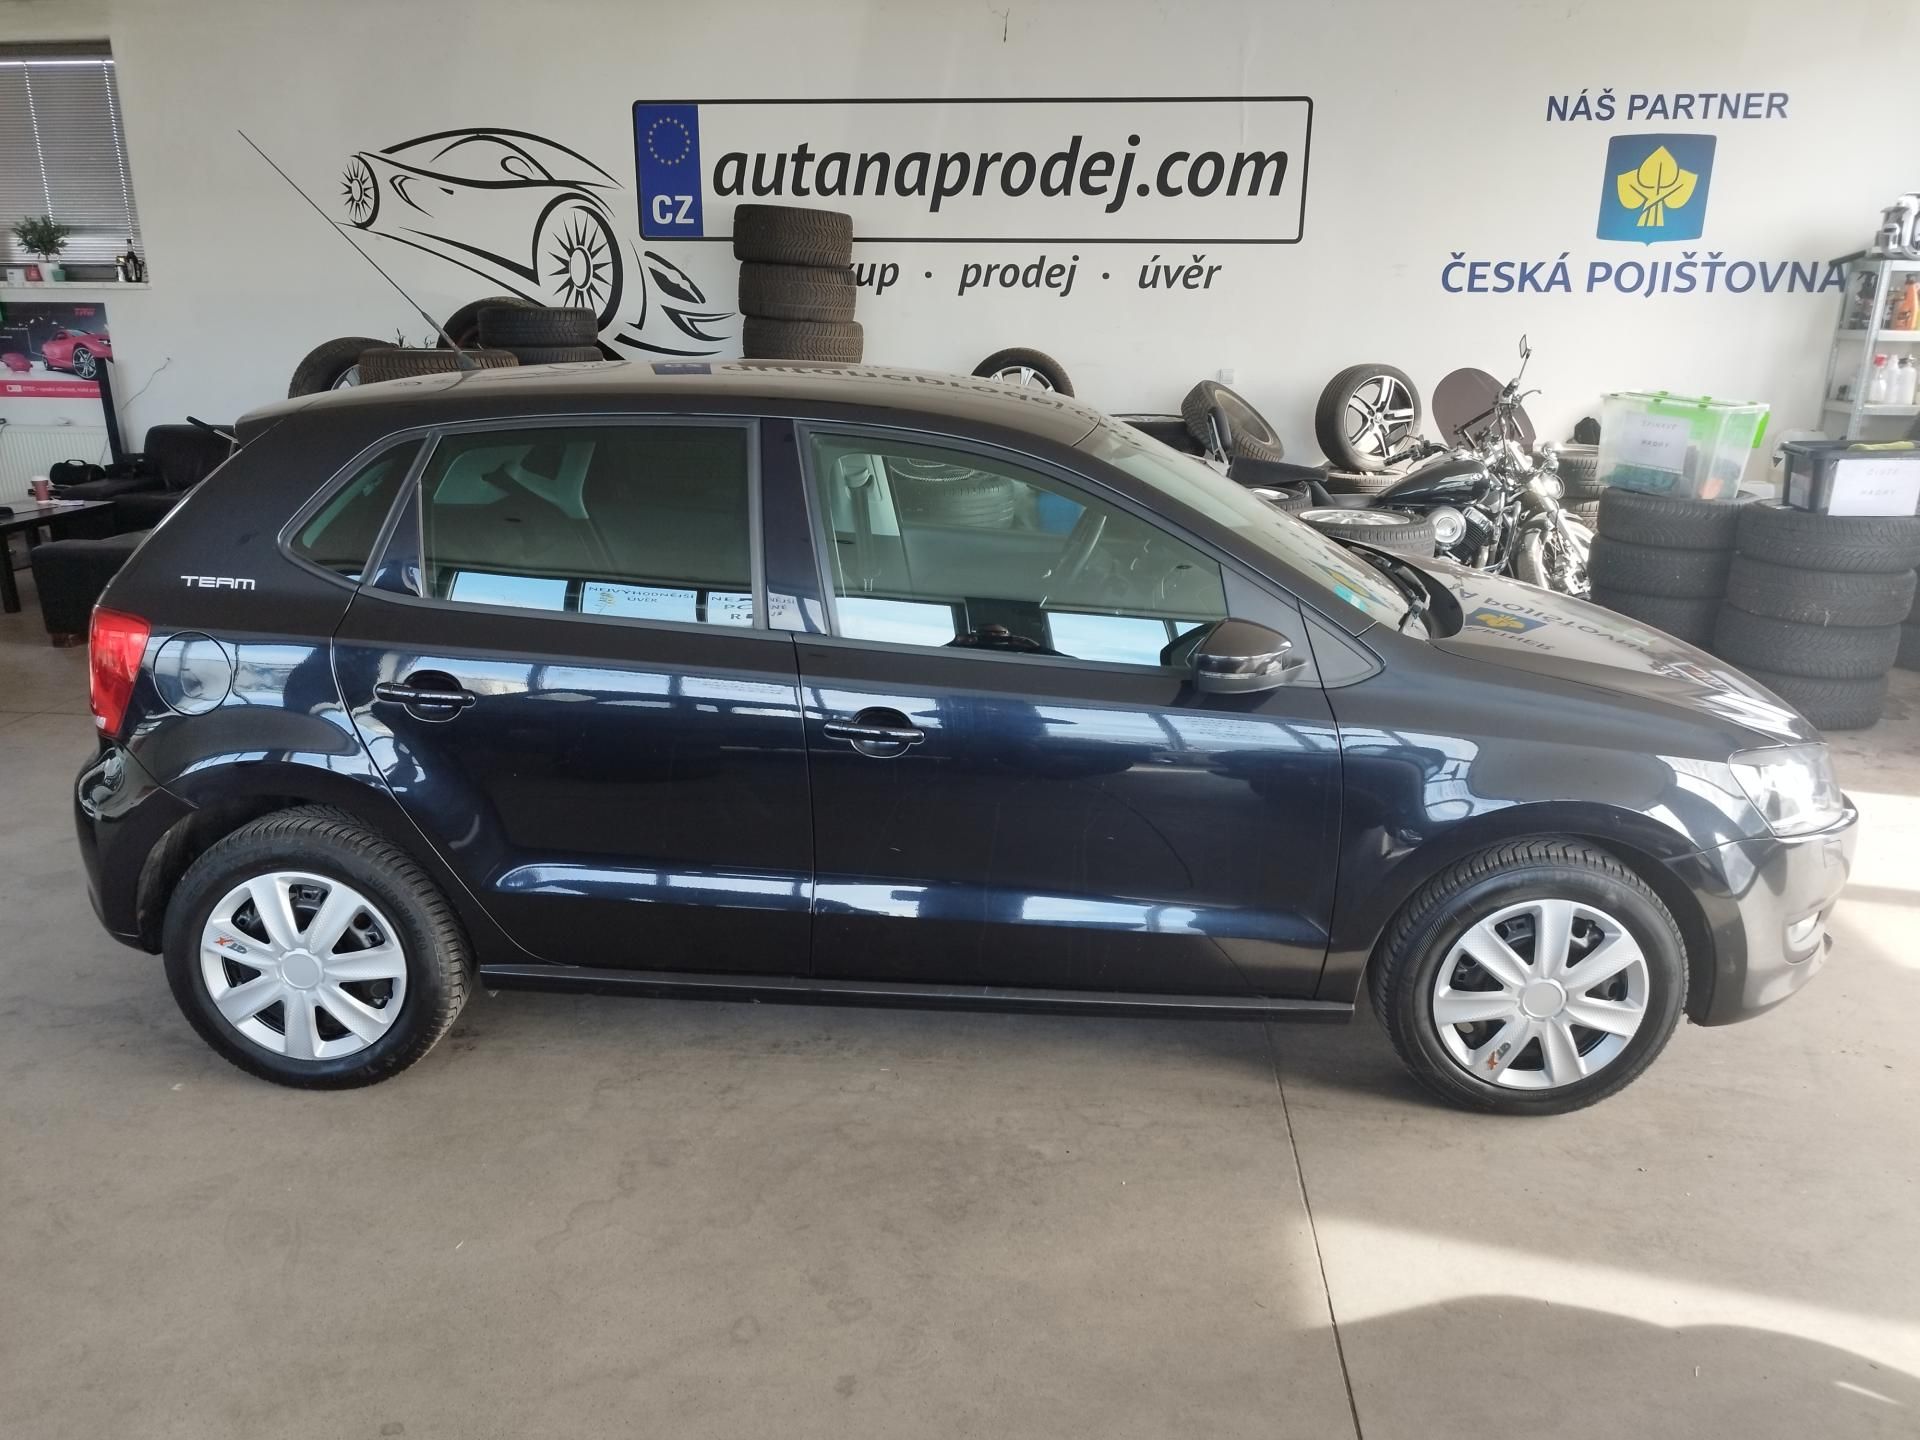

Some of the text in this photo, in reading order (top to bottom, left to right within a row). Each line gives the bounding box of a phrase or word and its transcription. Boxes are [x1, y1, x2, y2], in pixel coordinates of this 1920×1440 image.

[1546, 88, 1789, 121] NÁŠ PARTNER
[712, 134, 1290, 213] autanaprodej.com
[652, 194, 694, 225] CZ
[850, 254, 1223, 297] up prodej úvěr
[1441, 251, 1846, 298] ČESKÁ POJIŠŤOVNA
[180, 575, 256, 591] TEAM
